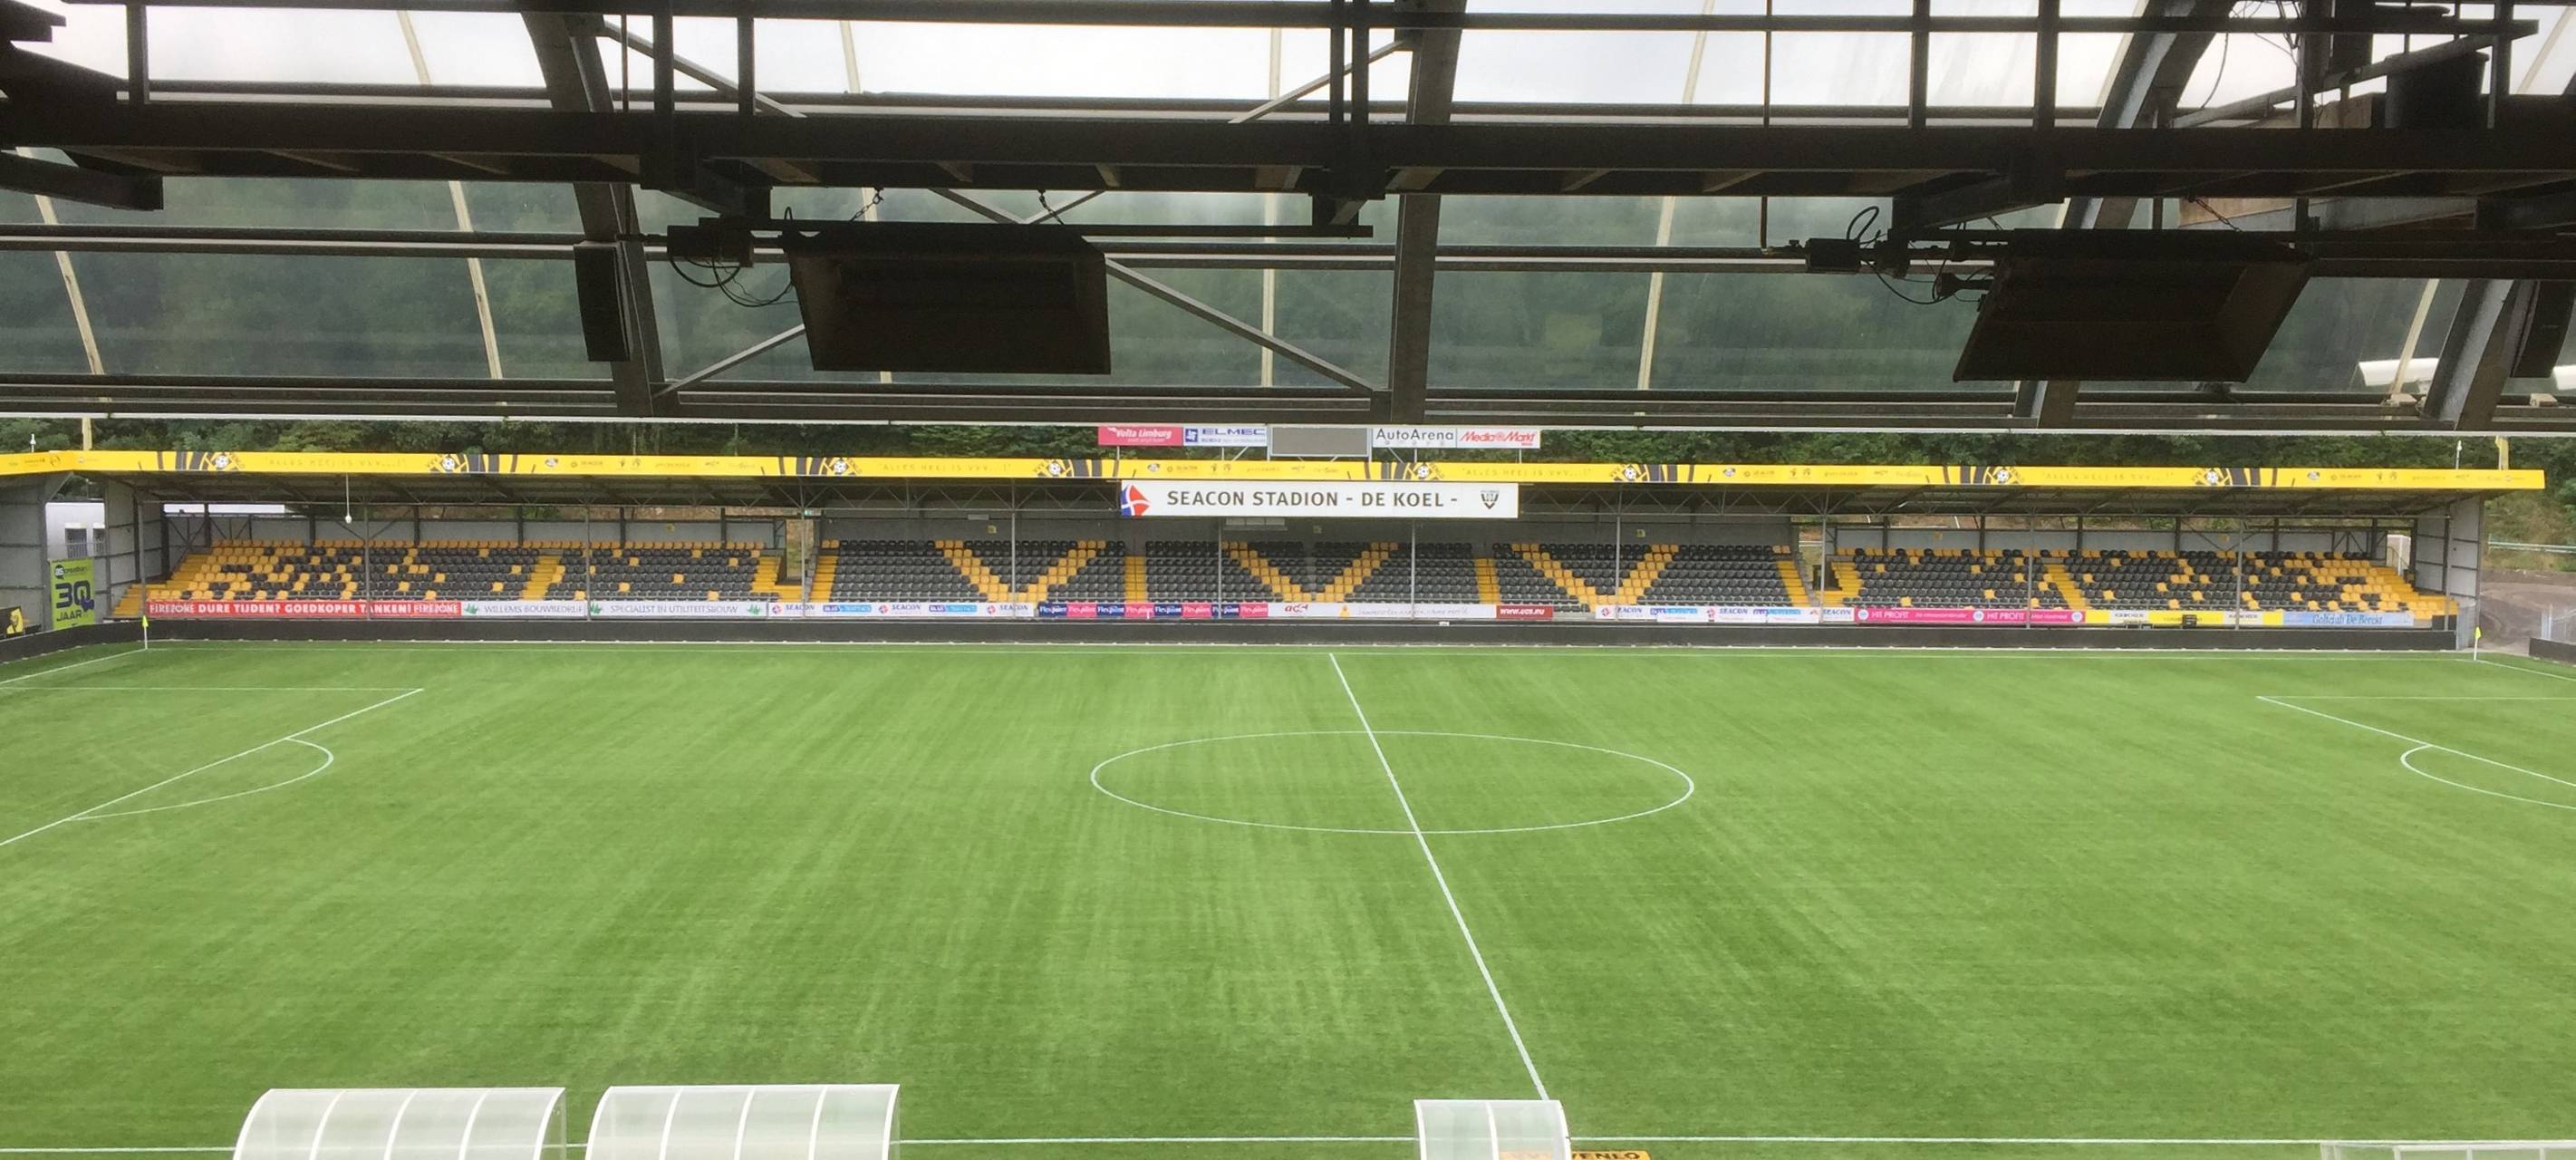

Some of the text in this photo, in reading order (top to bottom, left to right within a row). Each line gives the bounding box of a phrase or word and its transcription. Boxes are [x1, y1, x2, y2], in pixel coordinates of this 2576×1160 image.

[1138, 428, 1172, 440] Limburg
[1375, 427, 1454, 441] AutoArena
[1166, 490, 1245, 507] SEACON
[1252, 490, 1338, 508] STADION
[1361, 492, 1385, 508] DE
[1394, 492, 1444, 508] KOEL
[55, 580, 92, 609] 30
[198, 604, 230, 614] DURE
[234, 604, 281, 614] TIJDEN?
[285, 604, 357, 614] GOEDKOPER
[484, 604, 523, 614] WILLEMS
[611, 604, 655, 614] SPECIALIST
[658, 604, 667, 614] IN
[56, 610, 82, 622] JAAR
